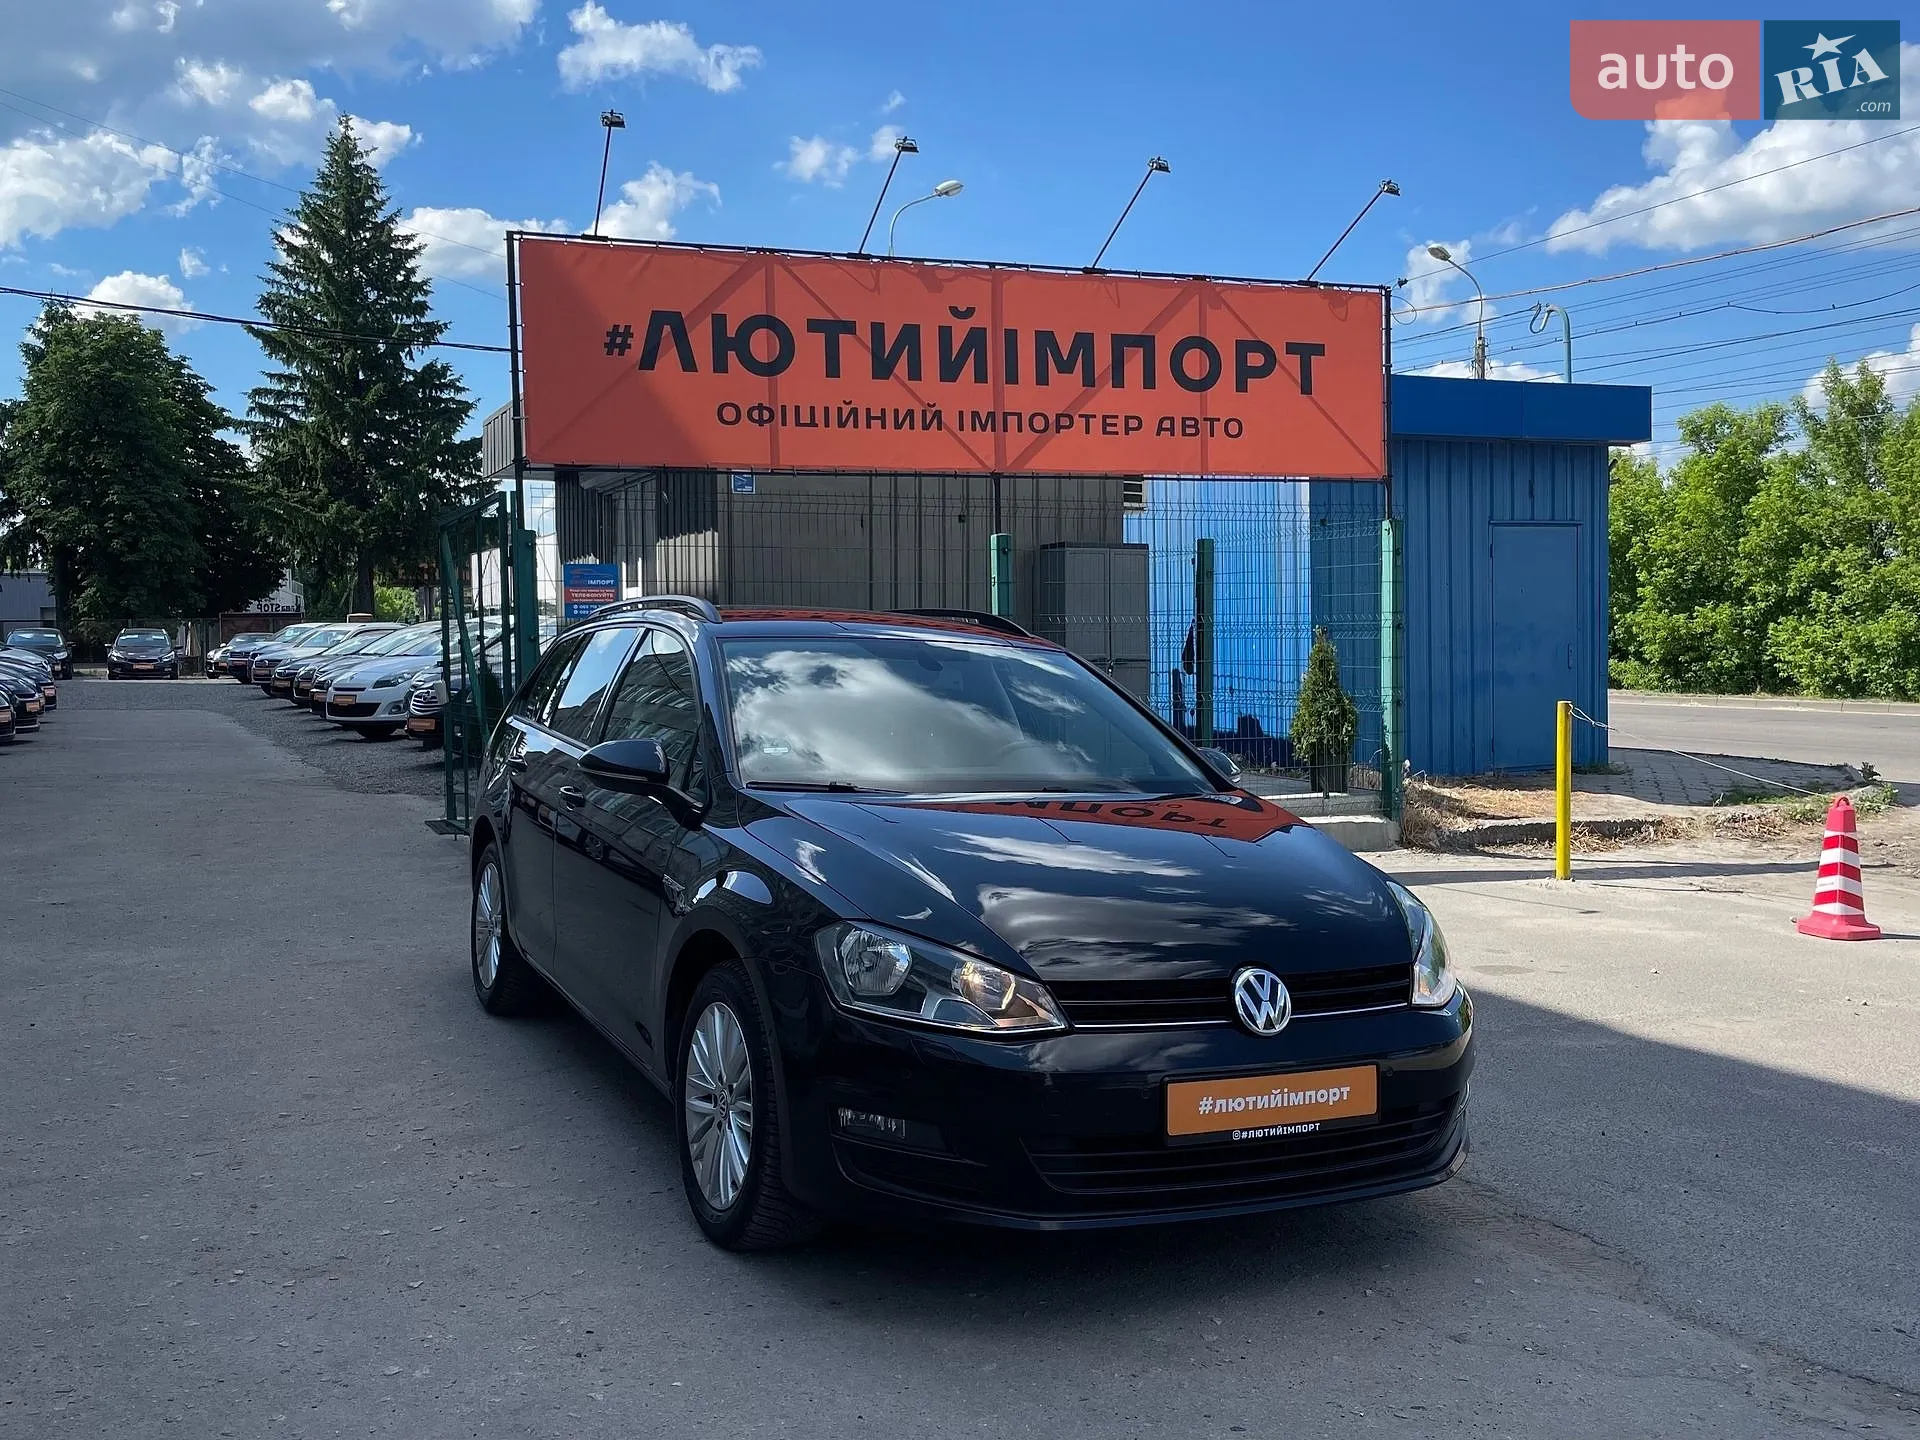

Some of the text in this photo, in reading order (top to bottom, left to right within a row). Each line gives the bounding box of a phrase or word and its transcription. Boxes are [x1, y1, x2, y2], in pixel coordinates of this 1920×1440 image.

[603, 305, 1326, 396] #ЛЮТИЙІМПОРТ
[716, 400, 1243, 439] ОФІЦІЙНИЙ ІМПОРТЕР АВТО
[1198, 1085, 1351, 1116] #лютийімпорт
